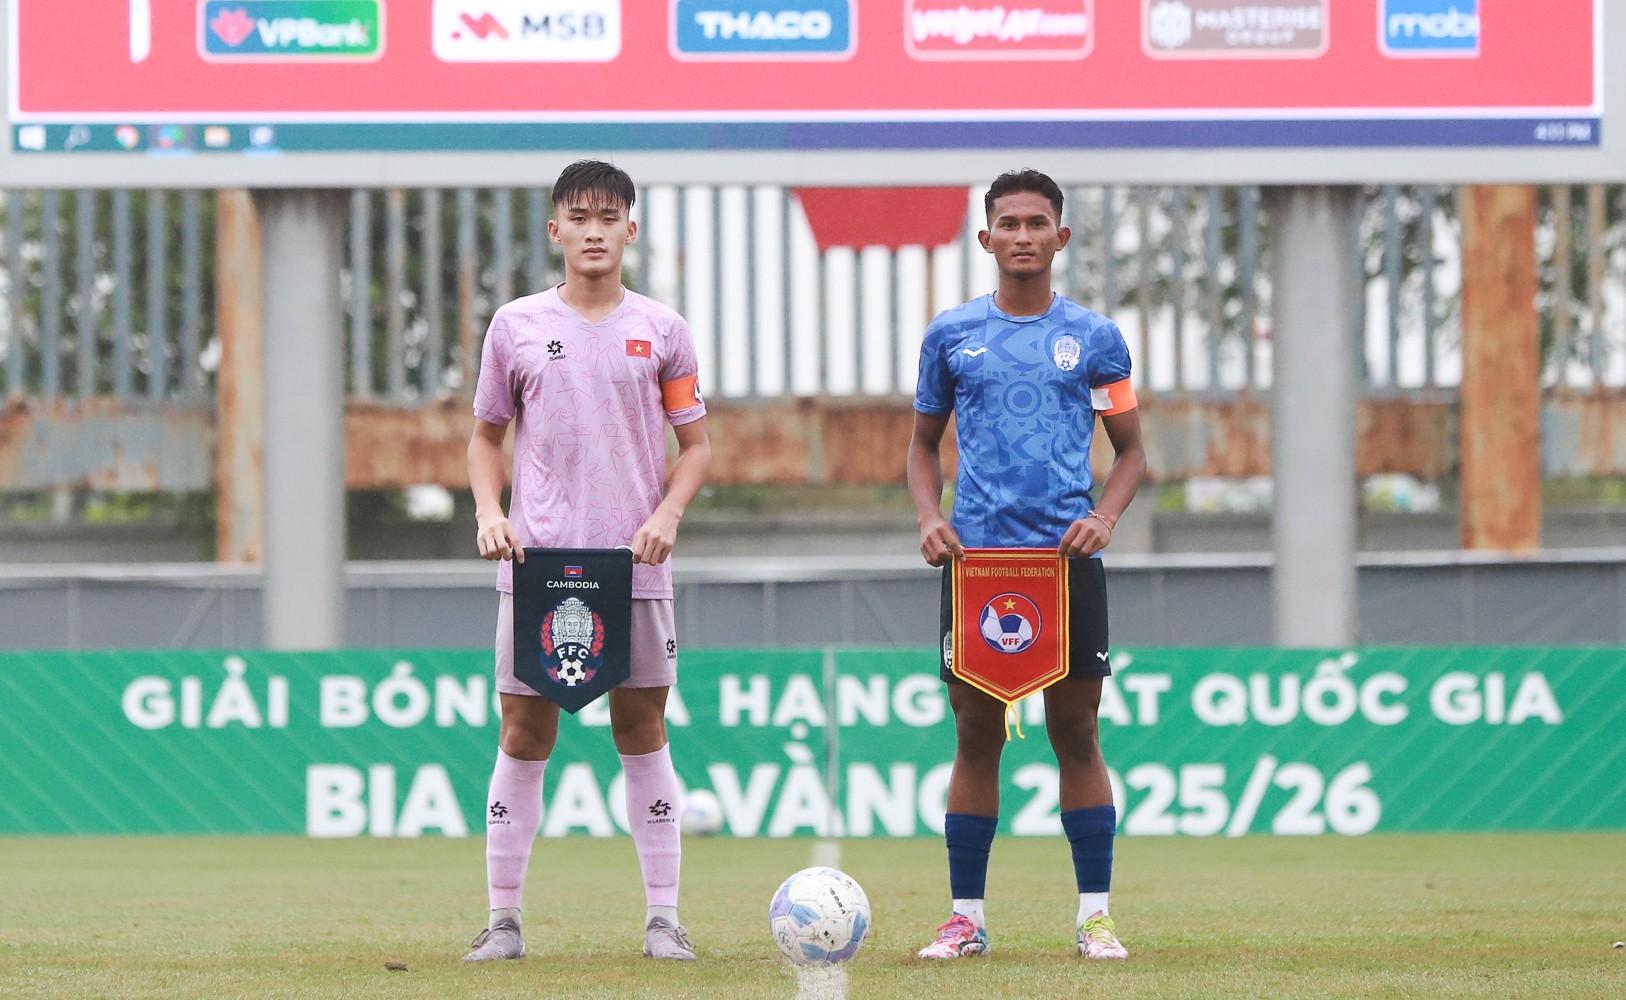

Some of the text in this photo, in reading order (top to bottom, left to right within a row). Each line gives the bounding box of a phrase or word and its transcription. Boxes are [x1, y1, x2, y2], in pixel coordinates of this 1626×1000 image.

[258, 15, 369, 48] VPBank
[521, 13, 606, 39] MSB
[694, 10, 832, 40] THACO
[546, 580, 600, 590] CAMBODIA
[965, 566, 1055, 578] VIETNAM FOOTBALL FEDERATION
[557, 645, 589, 660] FFC
[1002, 637, 1020, 646] VFF
[121, 656, 290, 730] GIẢI
[319, 660, 502, 729] BÓN
[719, 673, 945, 740] HẠNG
[1191, 651, 1409, 727] QUỐC
[1429, 670, 1564, 726] GIA
[306, 763, 469, 839] BIA
[1010, 754, 1382, 838] 225/26
